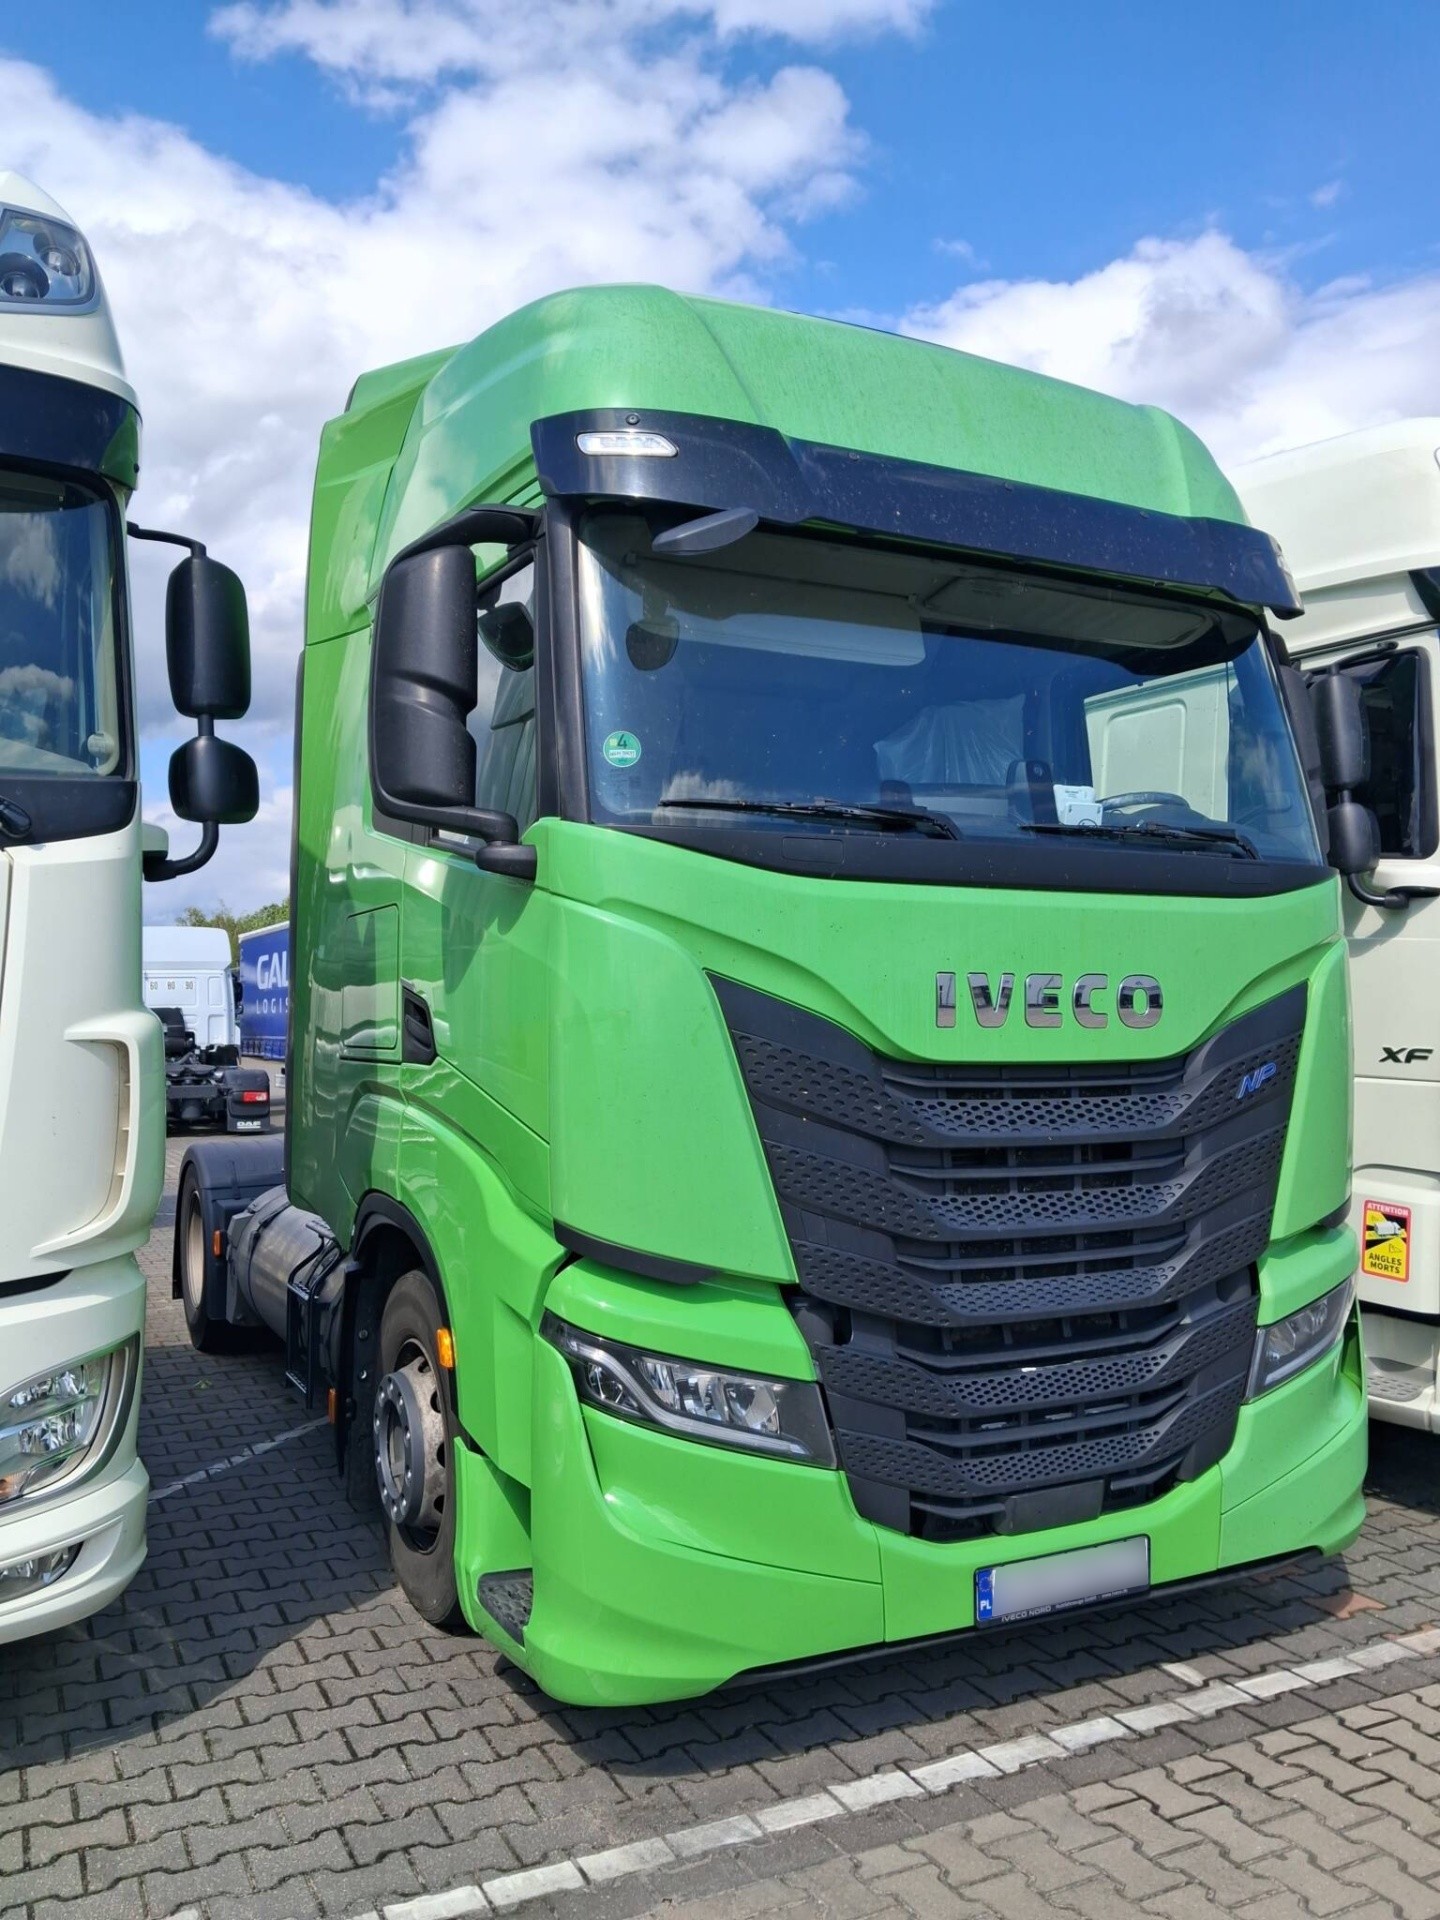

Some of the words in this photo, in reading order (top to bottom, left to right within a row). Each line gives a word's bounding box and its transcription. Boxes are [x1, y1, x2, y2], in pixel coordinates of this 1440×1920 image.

[617, 733, 628, 749] 4
[935, 971, 1164, 1029] IVECO
[1378, 1047, 1434, 1064] XF
[1237, 1062, 1277, 1099] NP
[237, 1121, 261, 1129] DAF
[1366, 1203, 1409, 1216] ATTENTION
[1369, 1252, 1402, 1266] ANGLES
[1370, 1261, 1400, 1274] MORTS
[980, 1599, 992, 1610] PL
[1002, 1610, 1028, 1622] IVECO
